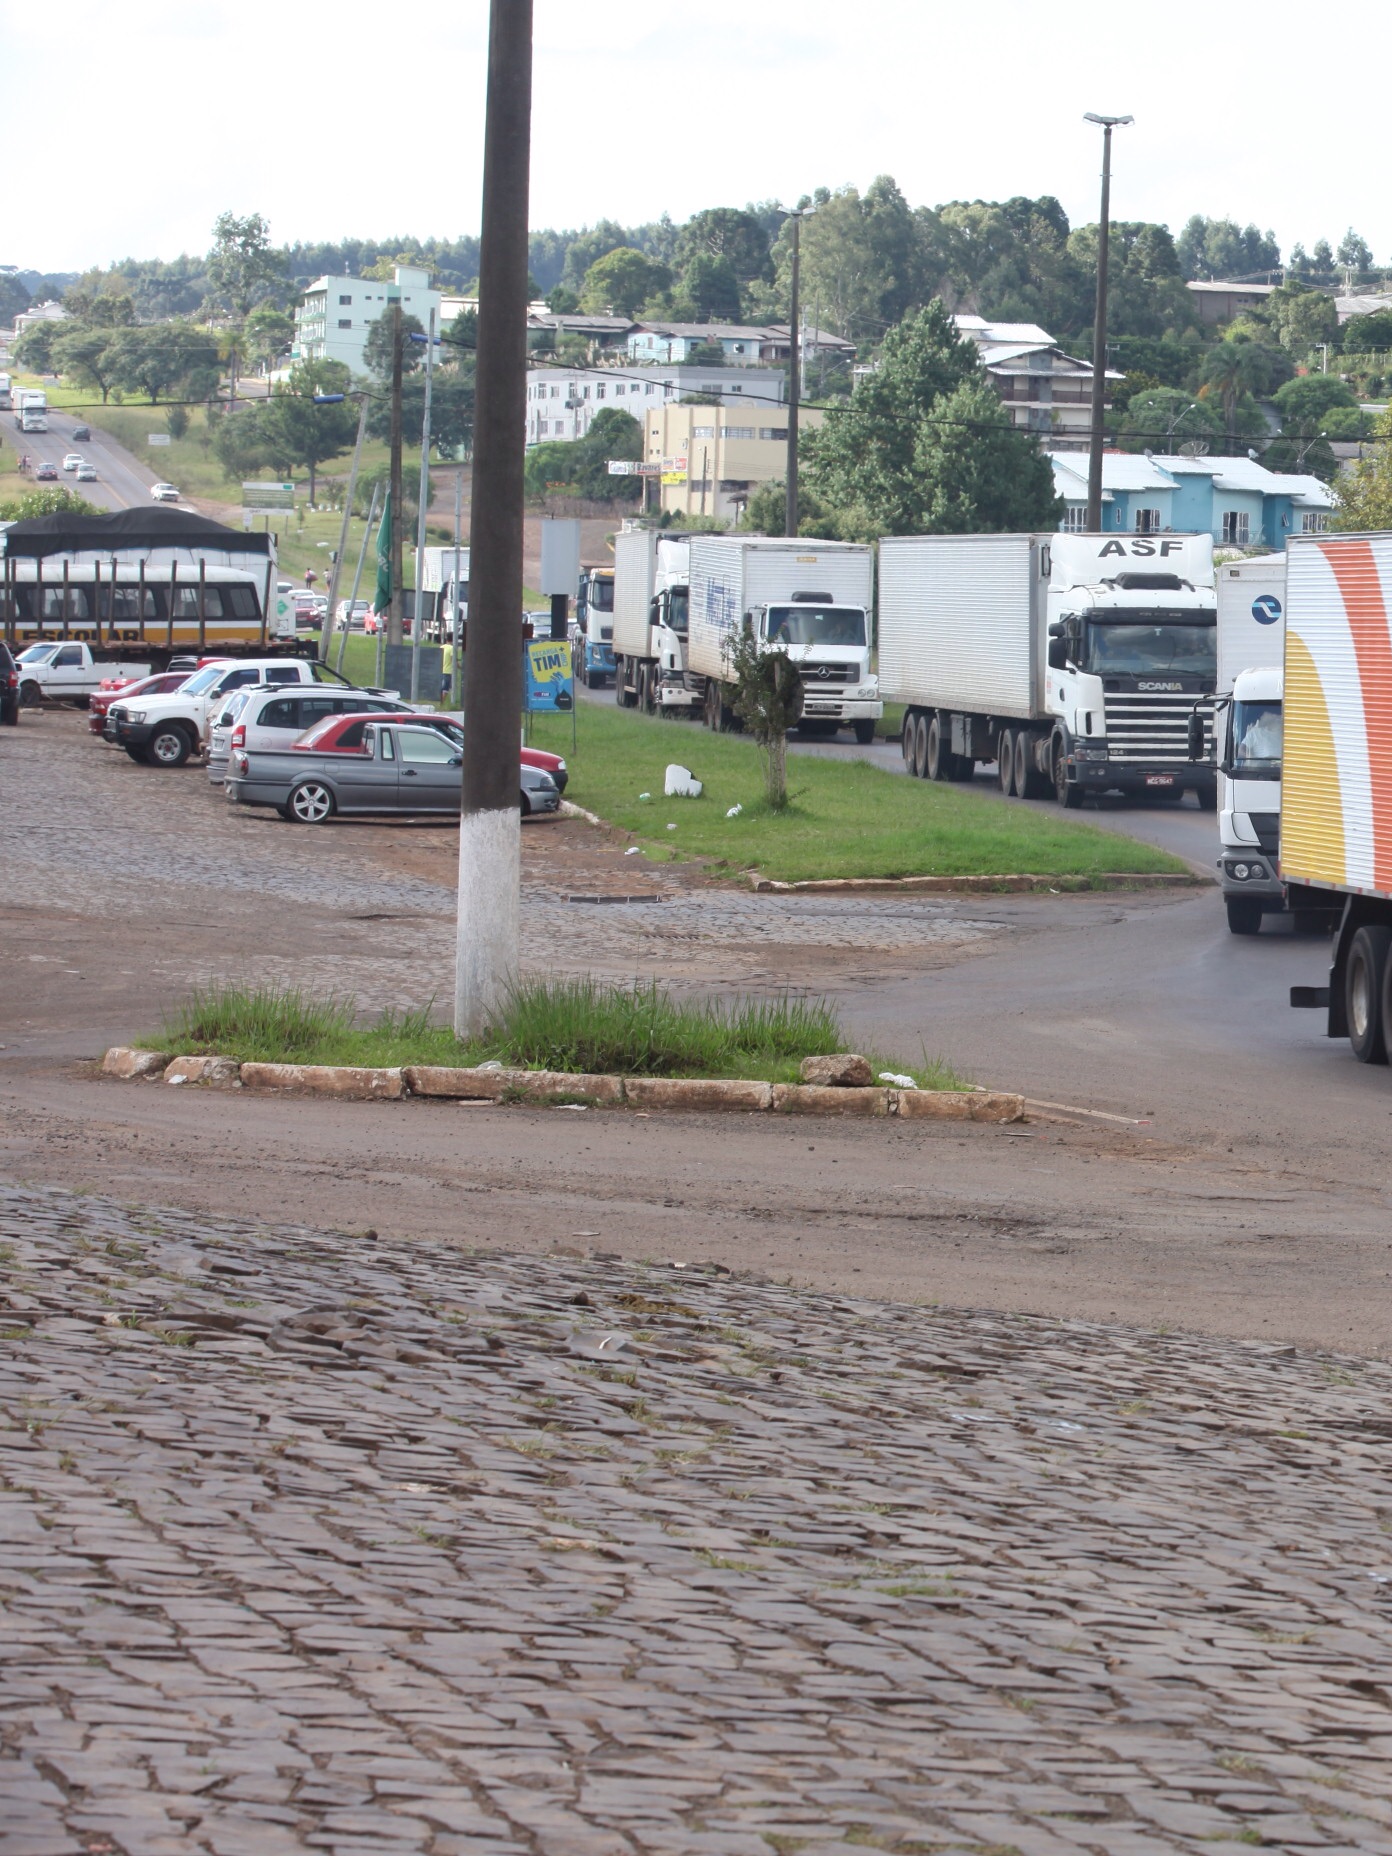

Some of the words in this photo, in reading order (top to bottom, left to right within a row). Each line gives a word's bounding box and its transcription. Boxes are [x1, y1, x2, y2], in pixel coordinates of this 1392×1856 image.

[1097, 539, 1184, 558] ASF
[533, 653, 562, 672] TIM
[1137, 682, 1183, 691] SCANIA
